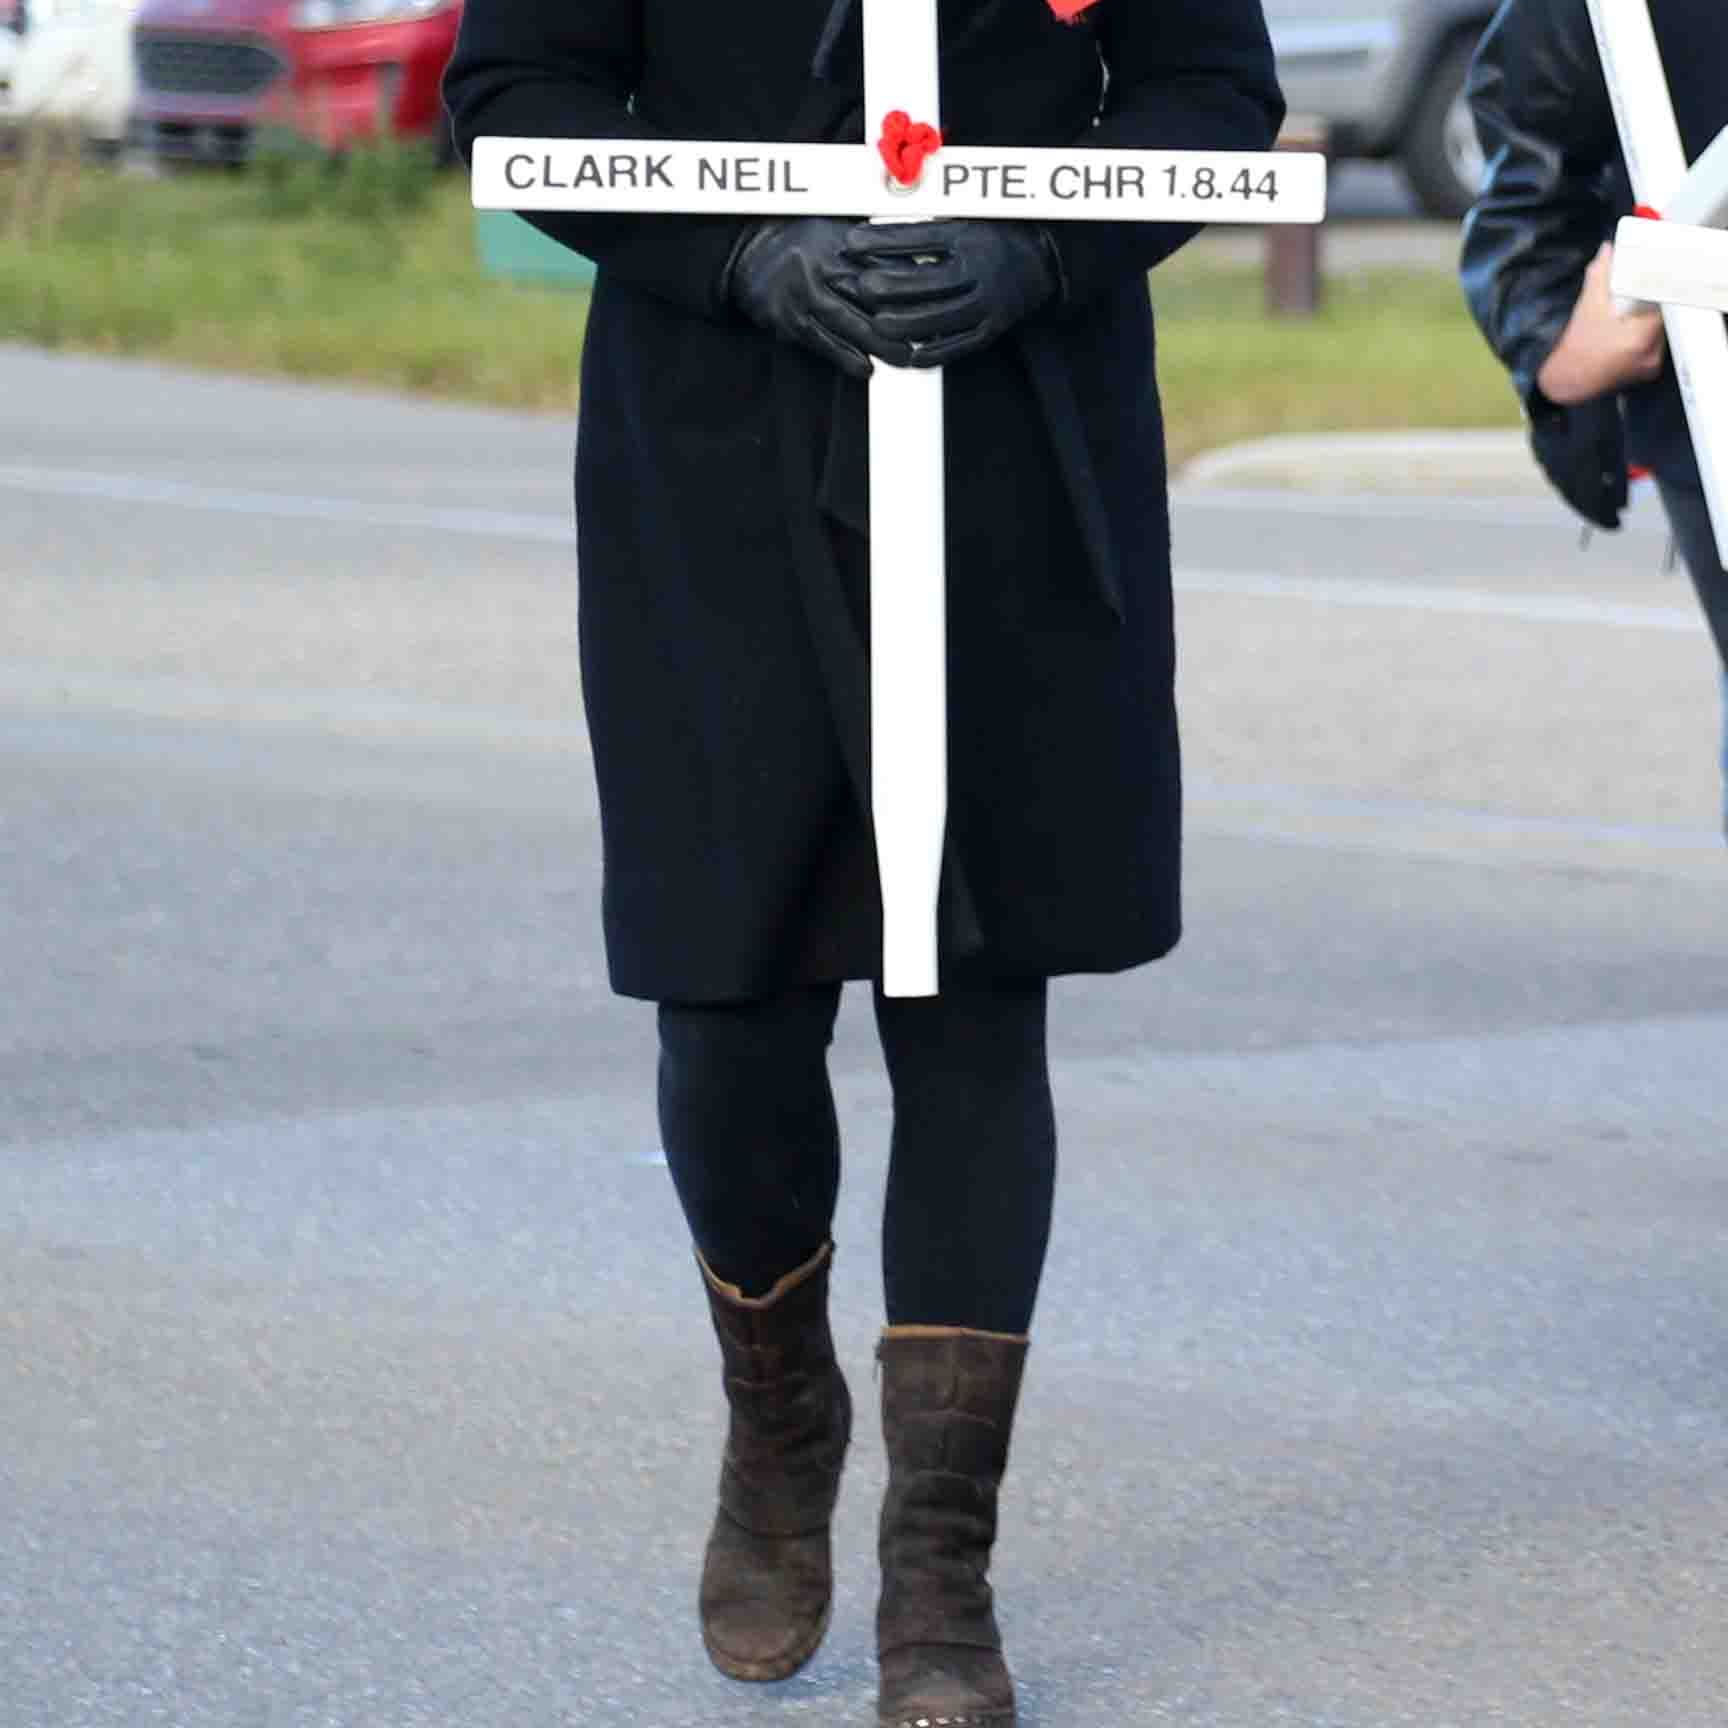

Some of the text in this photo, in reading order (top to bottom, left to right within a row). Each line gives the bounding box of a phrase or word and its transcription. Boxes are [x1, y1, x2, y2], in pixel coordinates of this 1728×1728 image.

[504, 154, 808, 192] CLARK NEIL
[943, 164, 1279, 202] PTE. CHR 1.8.44
